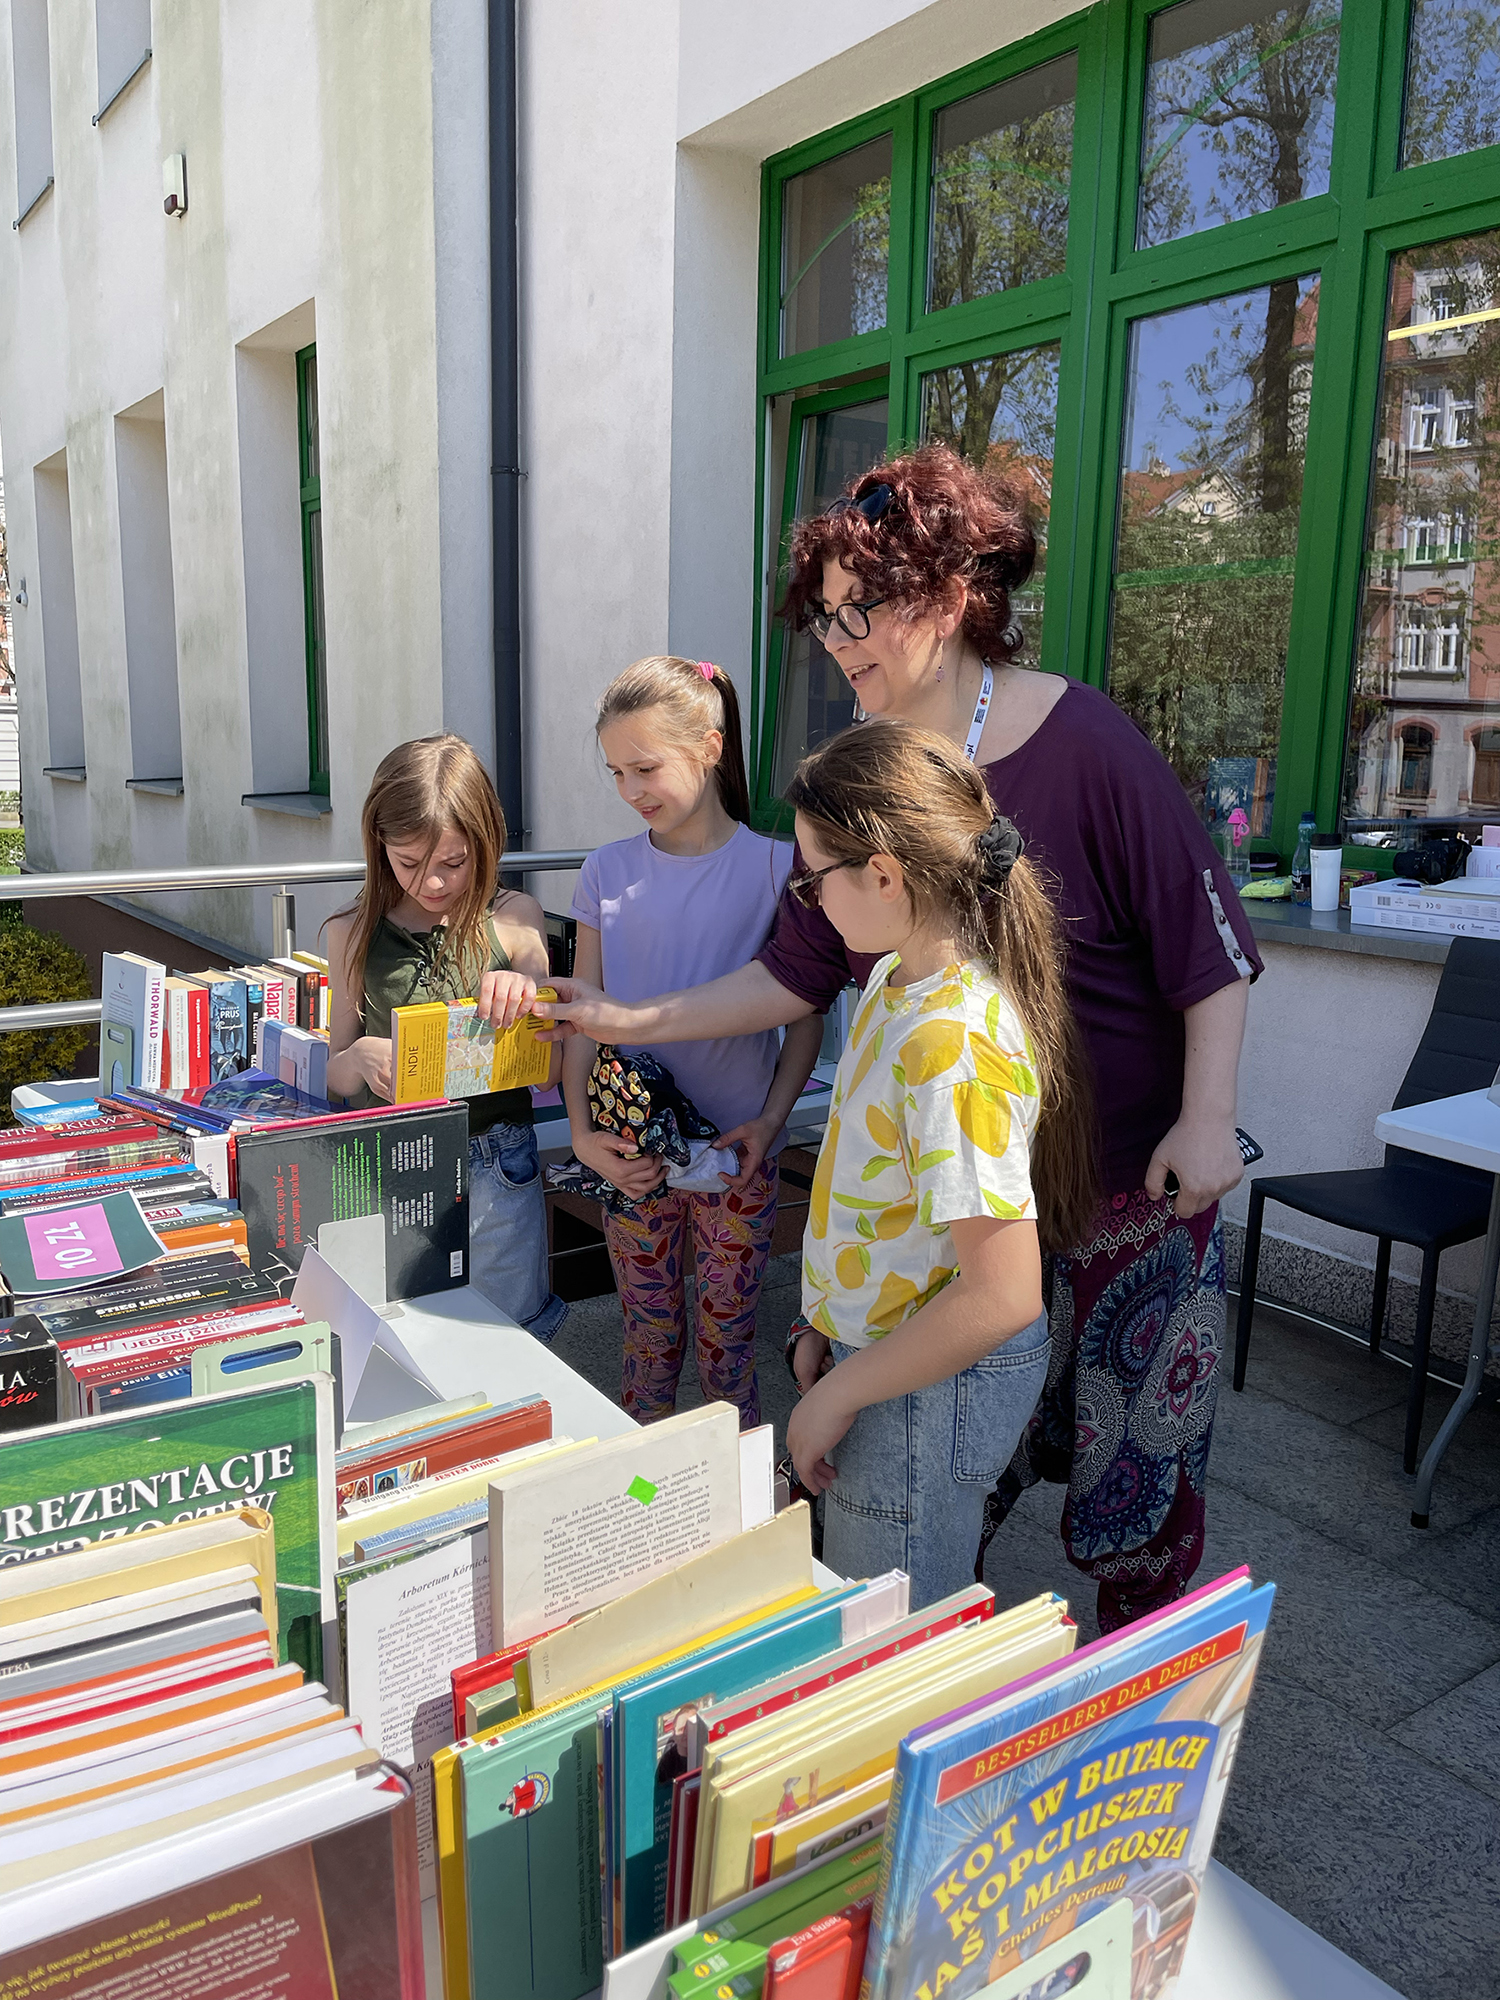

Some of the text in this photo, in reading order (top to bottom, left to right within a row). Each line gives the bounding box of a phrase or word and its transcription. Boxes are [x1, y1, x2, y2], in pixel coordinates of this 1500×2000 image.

[150, 981, 160, 1039] THORWALD
[220, 1010, 240, 1019] PRUS
[288, 987, 296, 1024] GRAND
[408, 1046, 418, 1077] INDIE
[66, 1115, 118, 1130] KREW
[105, 1178, 141, 1187] POLSKIEJ
[292, 1199, 302, 1224] samym
[278, 1224, 286, 1236] ma
[293, 1226, 303, 1244] poza
[55, 1247, 97, 1269] 10
[95, 1290, 201, 1315] STIEG LARSSON
[173, 1318, 198, 1326] TO
[130, 1334, 183, 1349] JEDEN
[87, 1365, 109, 1373] DAN
[113, 1356, 149, 1368] BROWN
[101, 1359, 169, 1379] BRIAN FREEMAN
[121, 1375, 150, 1387] David
[361, 1489, 401, 1504] Wolfgang
[434, 1467, 470, 1482] JESTEM
[470, 1457, 501, 1470] DOBRY
[0, 1444, 295, 1543] REZENTACJE
[398, 1573, 450, 1601] Arboretum
[494, 1648, 513, 1658] Moje
[973, 1642, 1220, 1779] BESTSELLERY DLA DZIECI
[932, 1812, 1019, 1914] KOT
[1029, 1778, 1070, 1826] W
[1075, 1735, 1210, 1803] BUTACH
[947, 1781, 1184, 1941] KOPCIUSZEK
[207, 1894, 263, 1923] WordPress!
[913, 1826, 1191, 2000] JAŚ I MAŁGOSIA
[998, 1873, 1129, 1957] Charles Perrault
[791, 1915, 841, 1946] Eva Susso
[27, 1966, 45, 1983] jak
